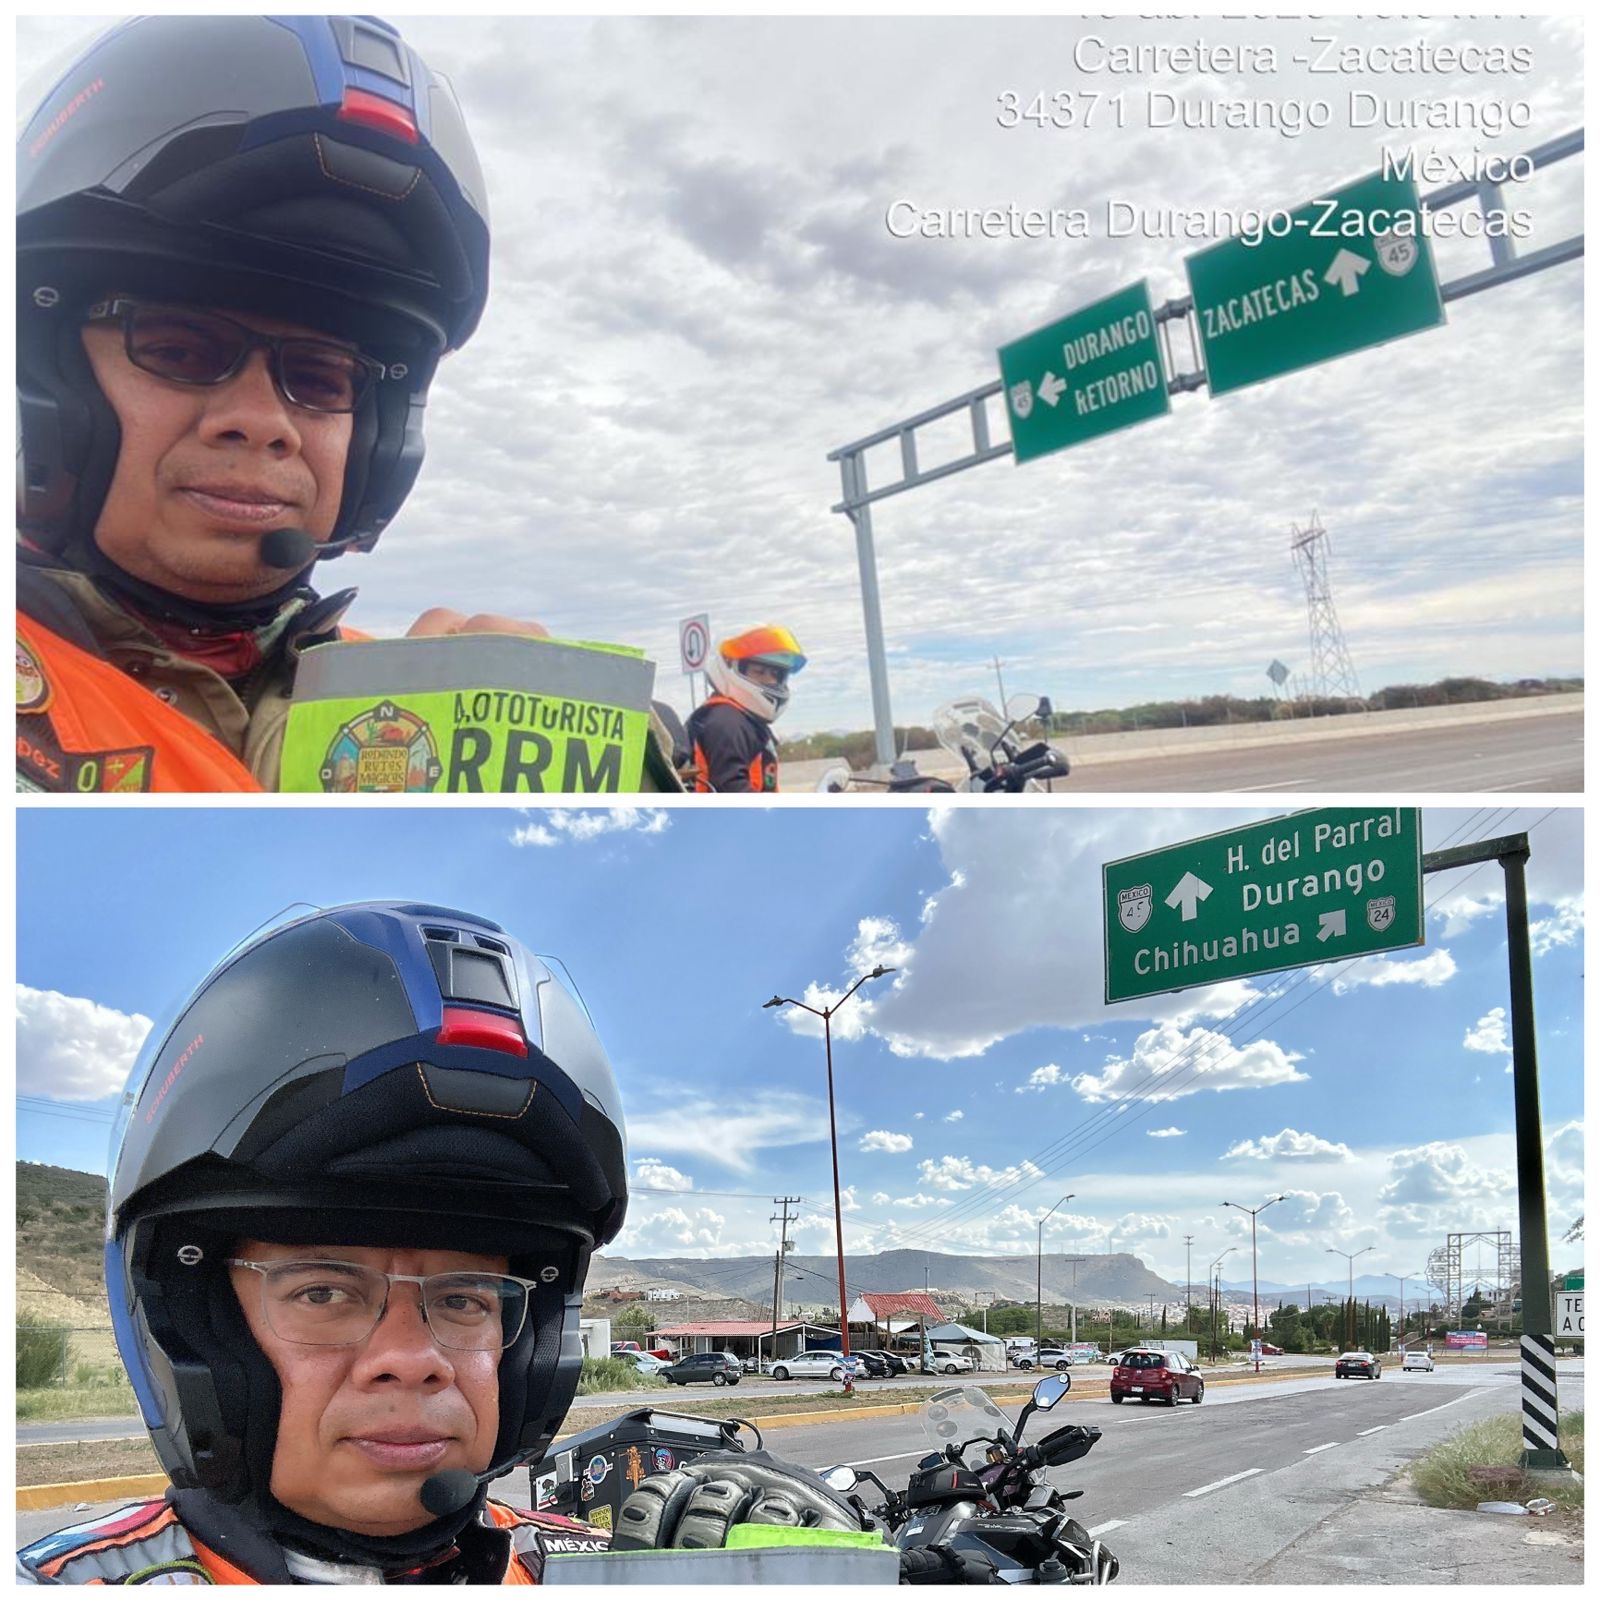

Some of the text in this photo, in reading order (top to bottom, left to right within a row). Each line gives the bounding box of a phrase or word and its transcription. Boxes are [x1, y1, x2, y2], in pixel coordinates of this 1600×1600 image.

[1388, 242, 1411, 264] 45
[1202, 268, 1320, 339] ZACATECAS
[1062, 310, 1151, 370] DURANGO
[1074, 360, 1158, 415] RETORNO
[379, 706, 395, 718] N
[428, 765, 441, 778] E
[446, 727, 624, 793] RRM
[1226, 808, 1402, 874] H. del Parral
[1121, 888, 1150, 902] MEXICO
[1241, 858, 1385, 911] Durango
[1373, 908, 1390, 923] 24
[1133, 922, 1301, 976] Chihuahua
[145, 1034, 204, 1124] SCHUBERTH
[1562, 1316, 1573, 1332] A
